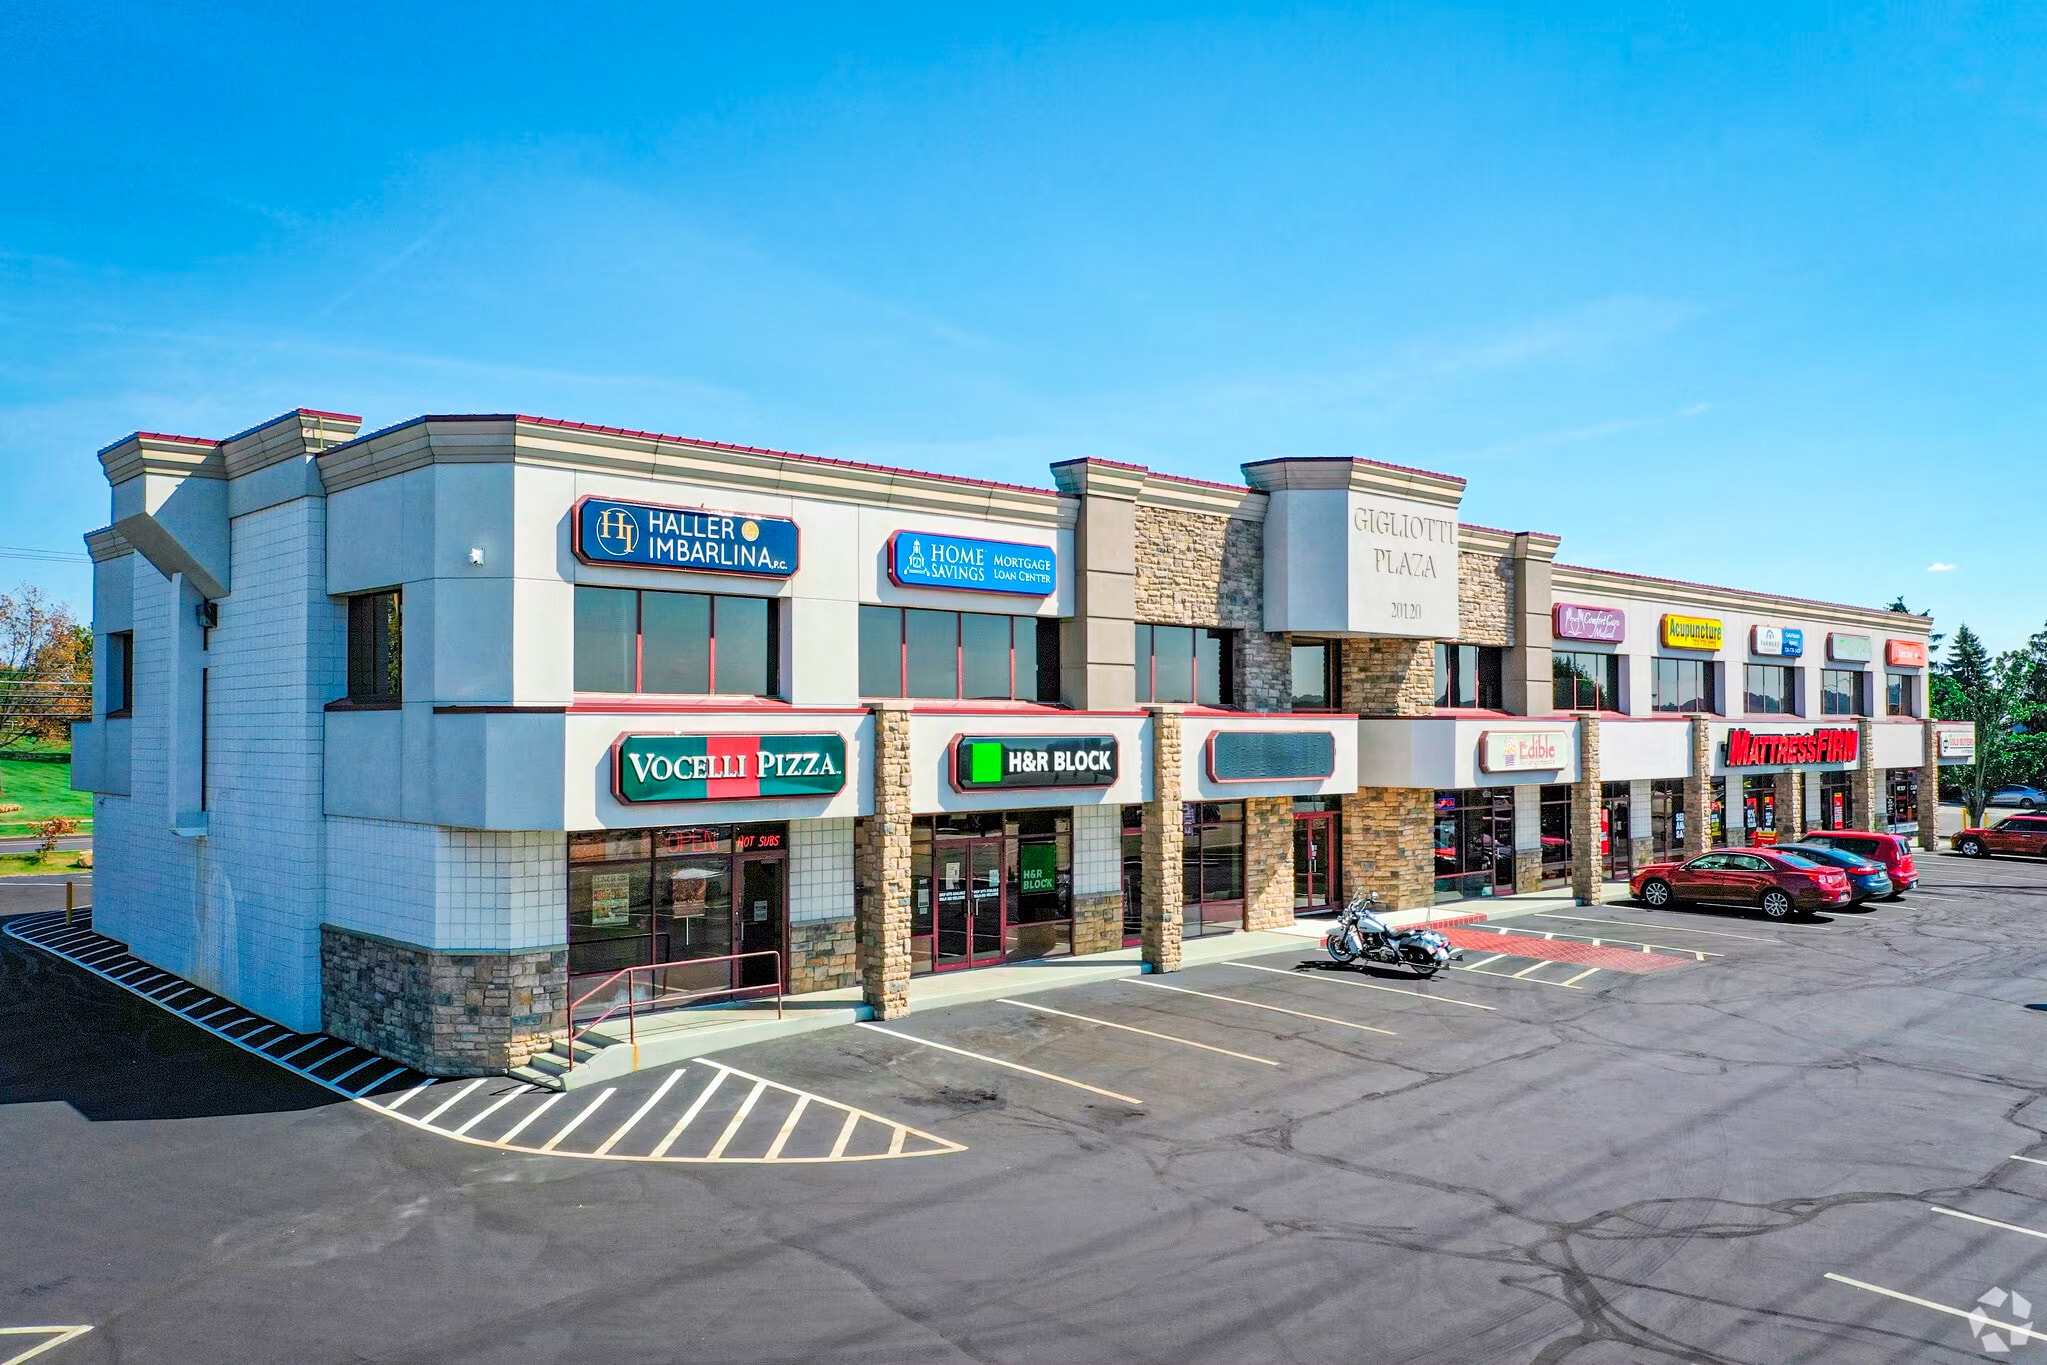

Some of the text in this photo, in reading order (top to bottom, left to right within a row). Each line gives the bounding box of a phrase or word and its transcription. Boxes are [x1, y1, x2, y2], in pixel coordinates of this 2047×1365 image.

[649, 510, 735, 540] HALLER
[1354, 507, 1454, 545] GIGLIOTTI
[930, 543, 984, 566] HOME
[1373, 547, 1437, 579] PLAZA
[931, 562, 985, 582] SAVINGS
[1391, 602, 1422, 620] 20120
[1669, 618, 1722, 641] Acupuncture
[1519, 734, 1555, 759] Edible
[628, 750, 836, 783] VOCELLI PIZZA
[1008, 750, 1111, 773] H&R BLOCK
[667, 828, 718, 853] OPEN
[737, 835, 780, 848] HOT SUBS
[1023, 869, 1043, 880] H&R
[1023, 878, 1053, 890] BLOCK
